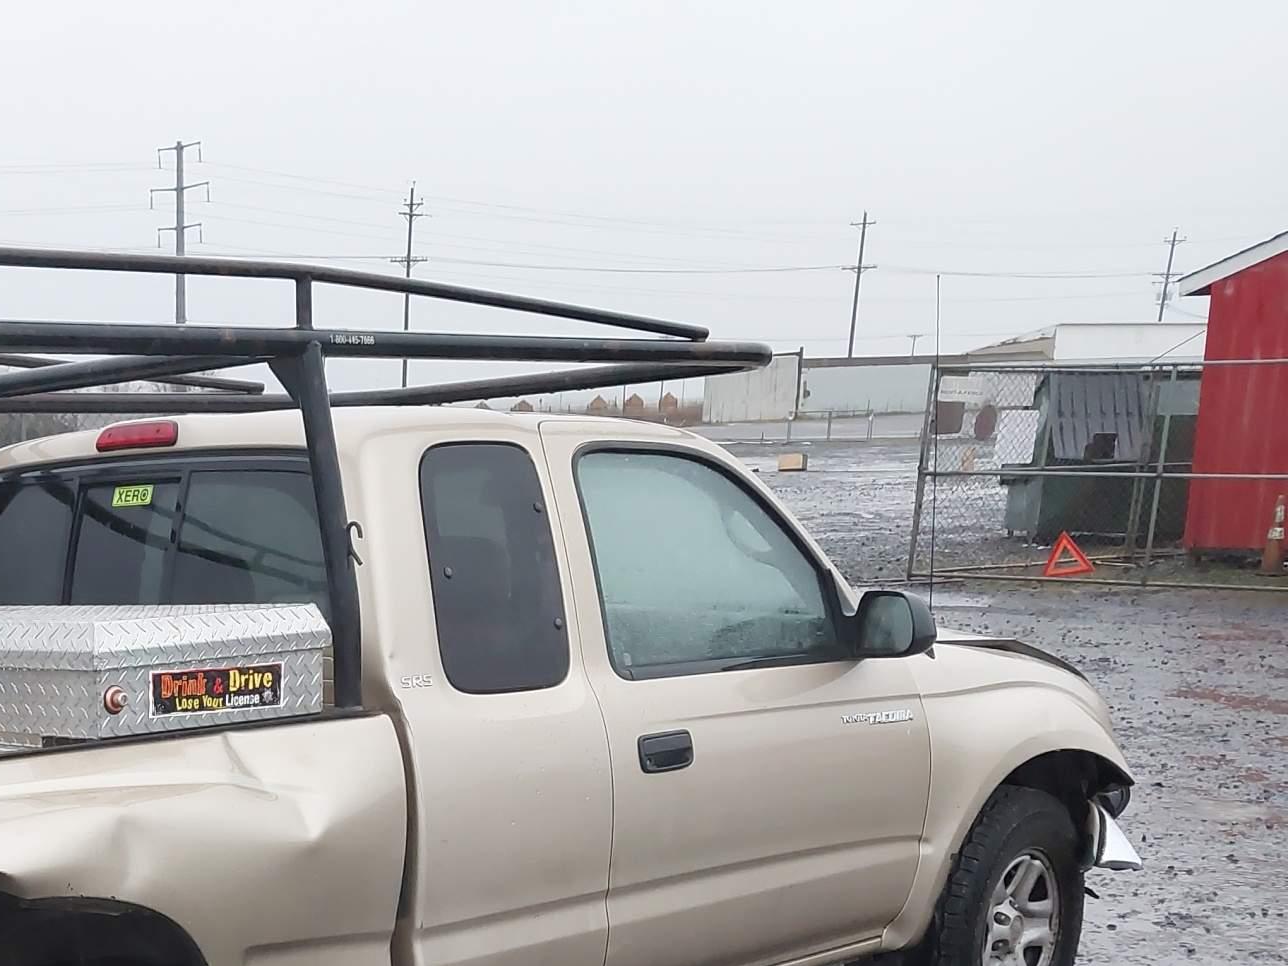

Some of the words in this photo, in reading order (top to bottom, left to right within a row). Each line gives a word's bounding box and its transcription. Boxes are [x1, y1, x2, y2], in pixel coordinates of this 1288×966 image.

[116, 489, 149, 503] XERO
[161, 673, 207, 698] Drink
[214, 677, 223, 694] &
[229, 669, 272, 691] Drive
[175, 698, 199, 710] Lose
[202, 695, 223, 708] Your
[226, 693, 260, 706] License
